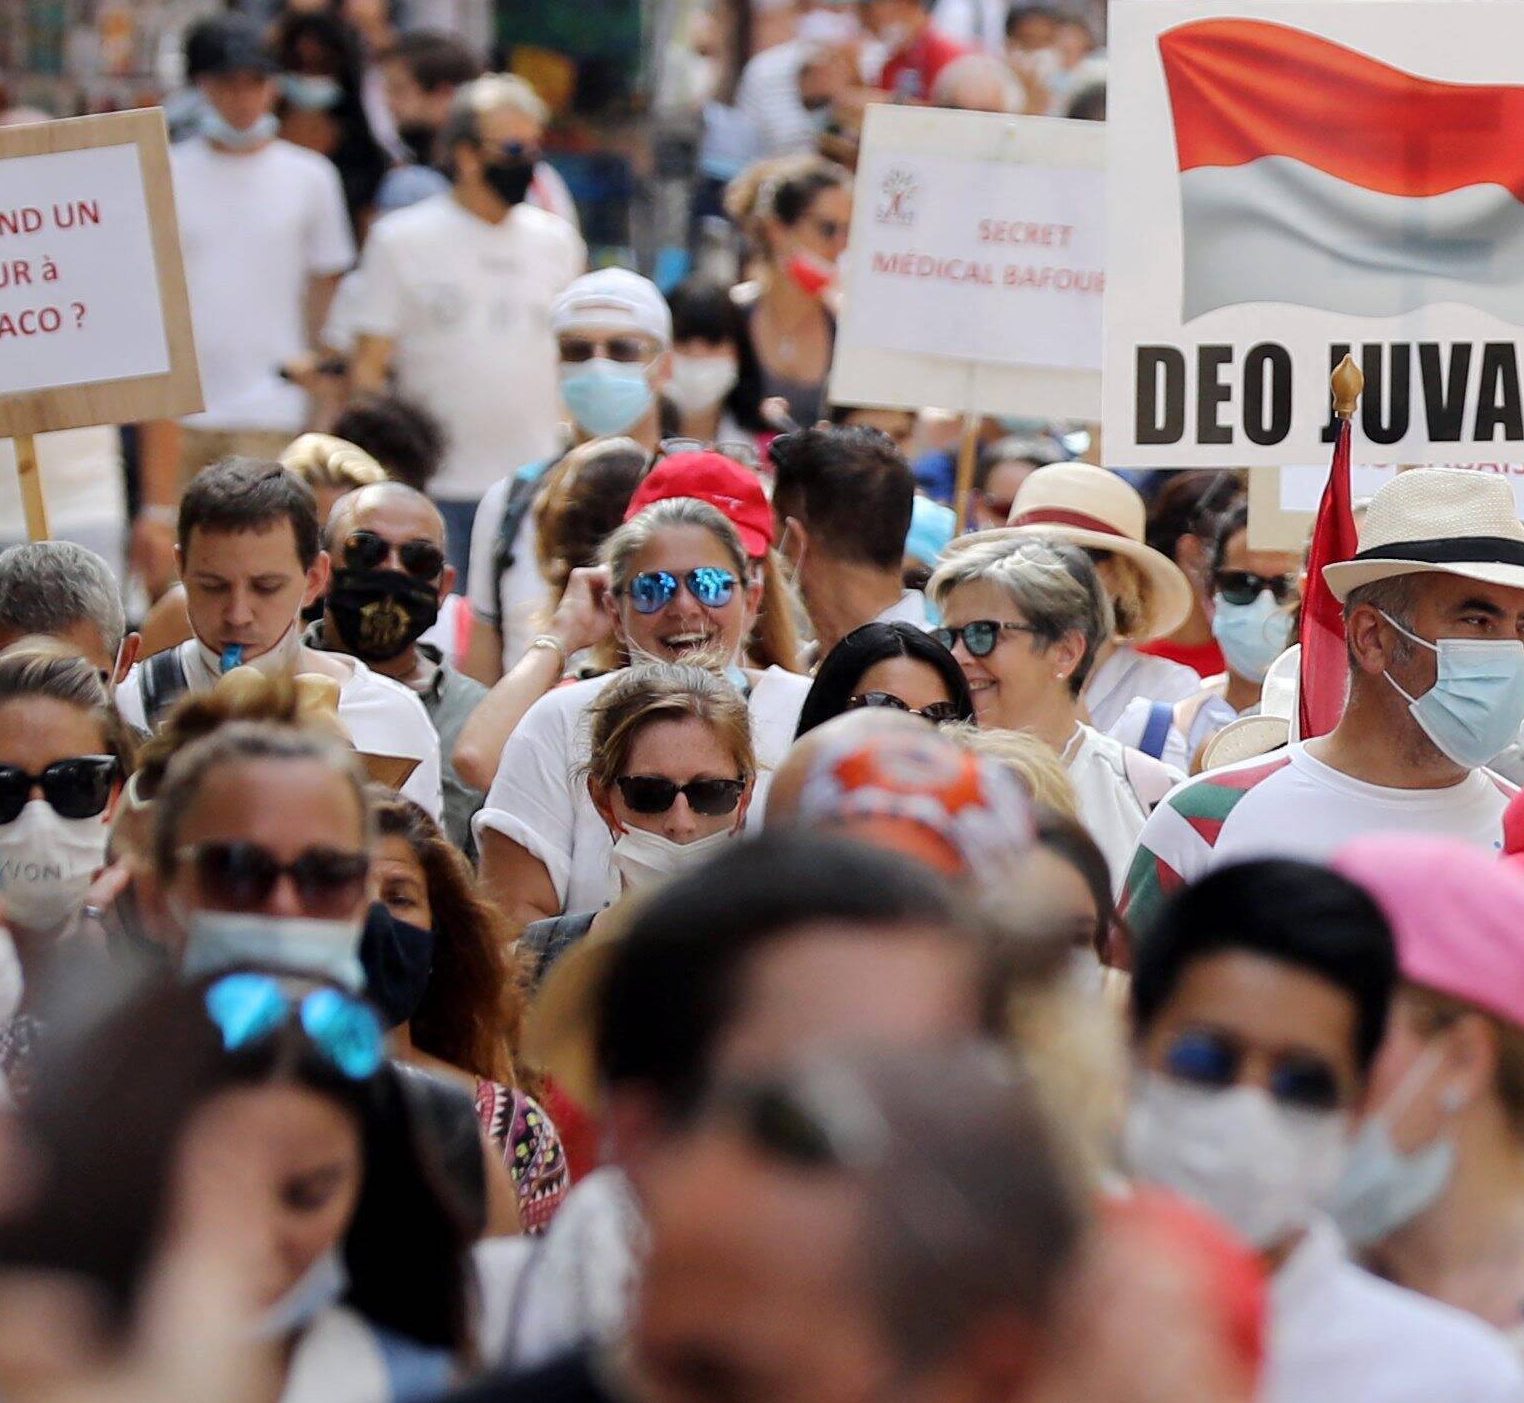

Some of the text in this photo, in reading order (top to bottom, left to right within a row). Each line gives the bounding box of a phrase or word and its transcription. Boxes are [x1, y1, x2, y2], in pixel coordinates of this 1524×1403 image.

[52, 200, 100, 229] UN
[978, 218, 1076, 248] SECRET
[42, 254, 59, 282] à
[872, 250, 994, 285] MÉDICAL
[71, 302, 86, 329] ?
[1134, 342, 1294, 446] DEO
